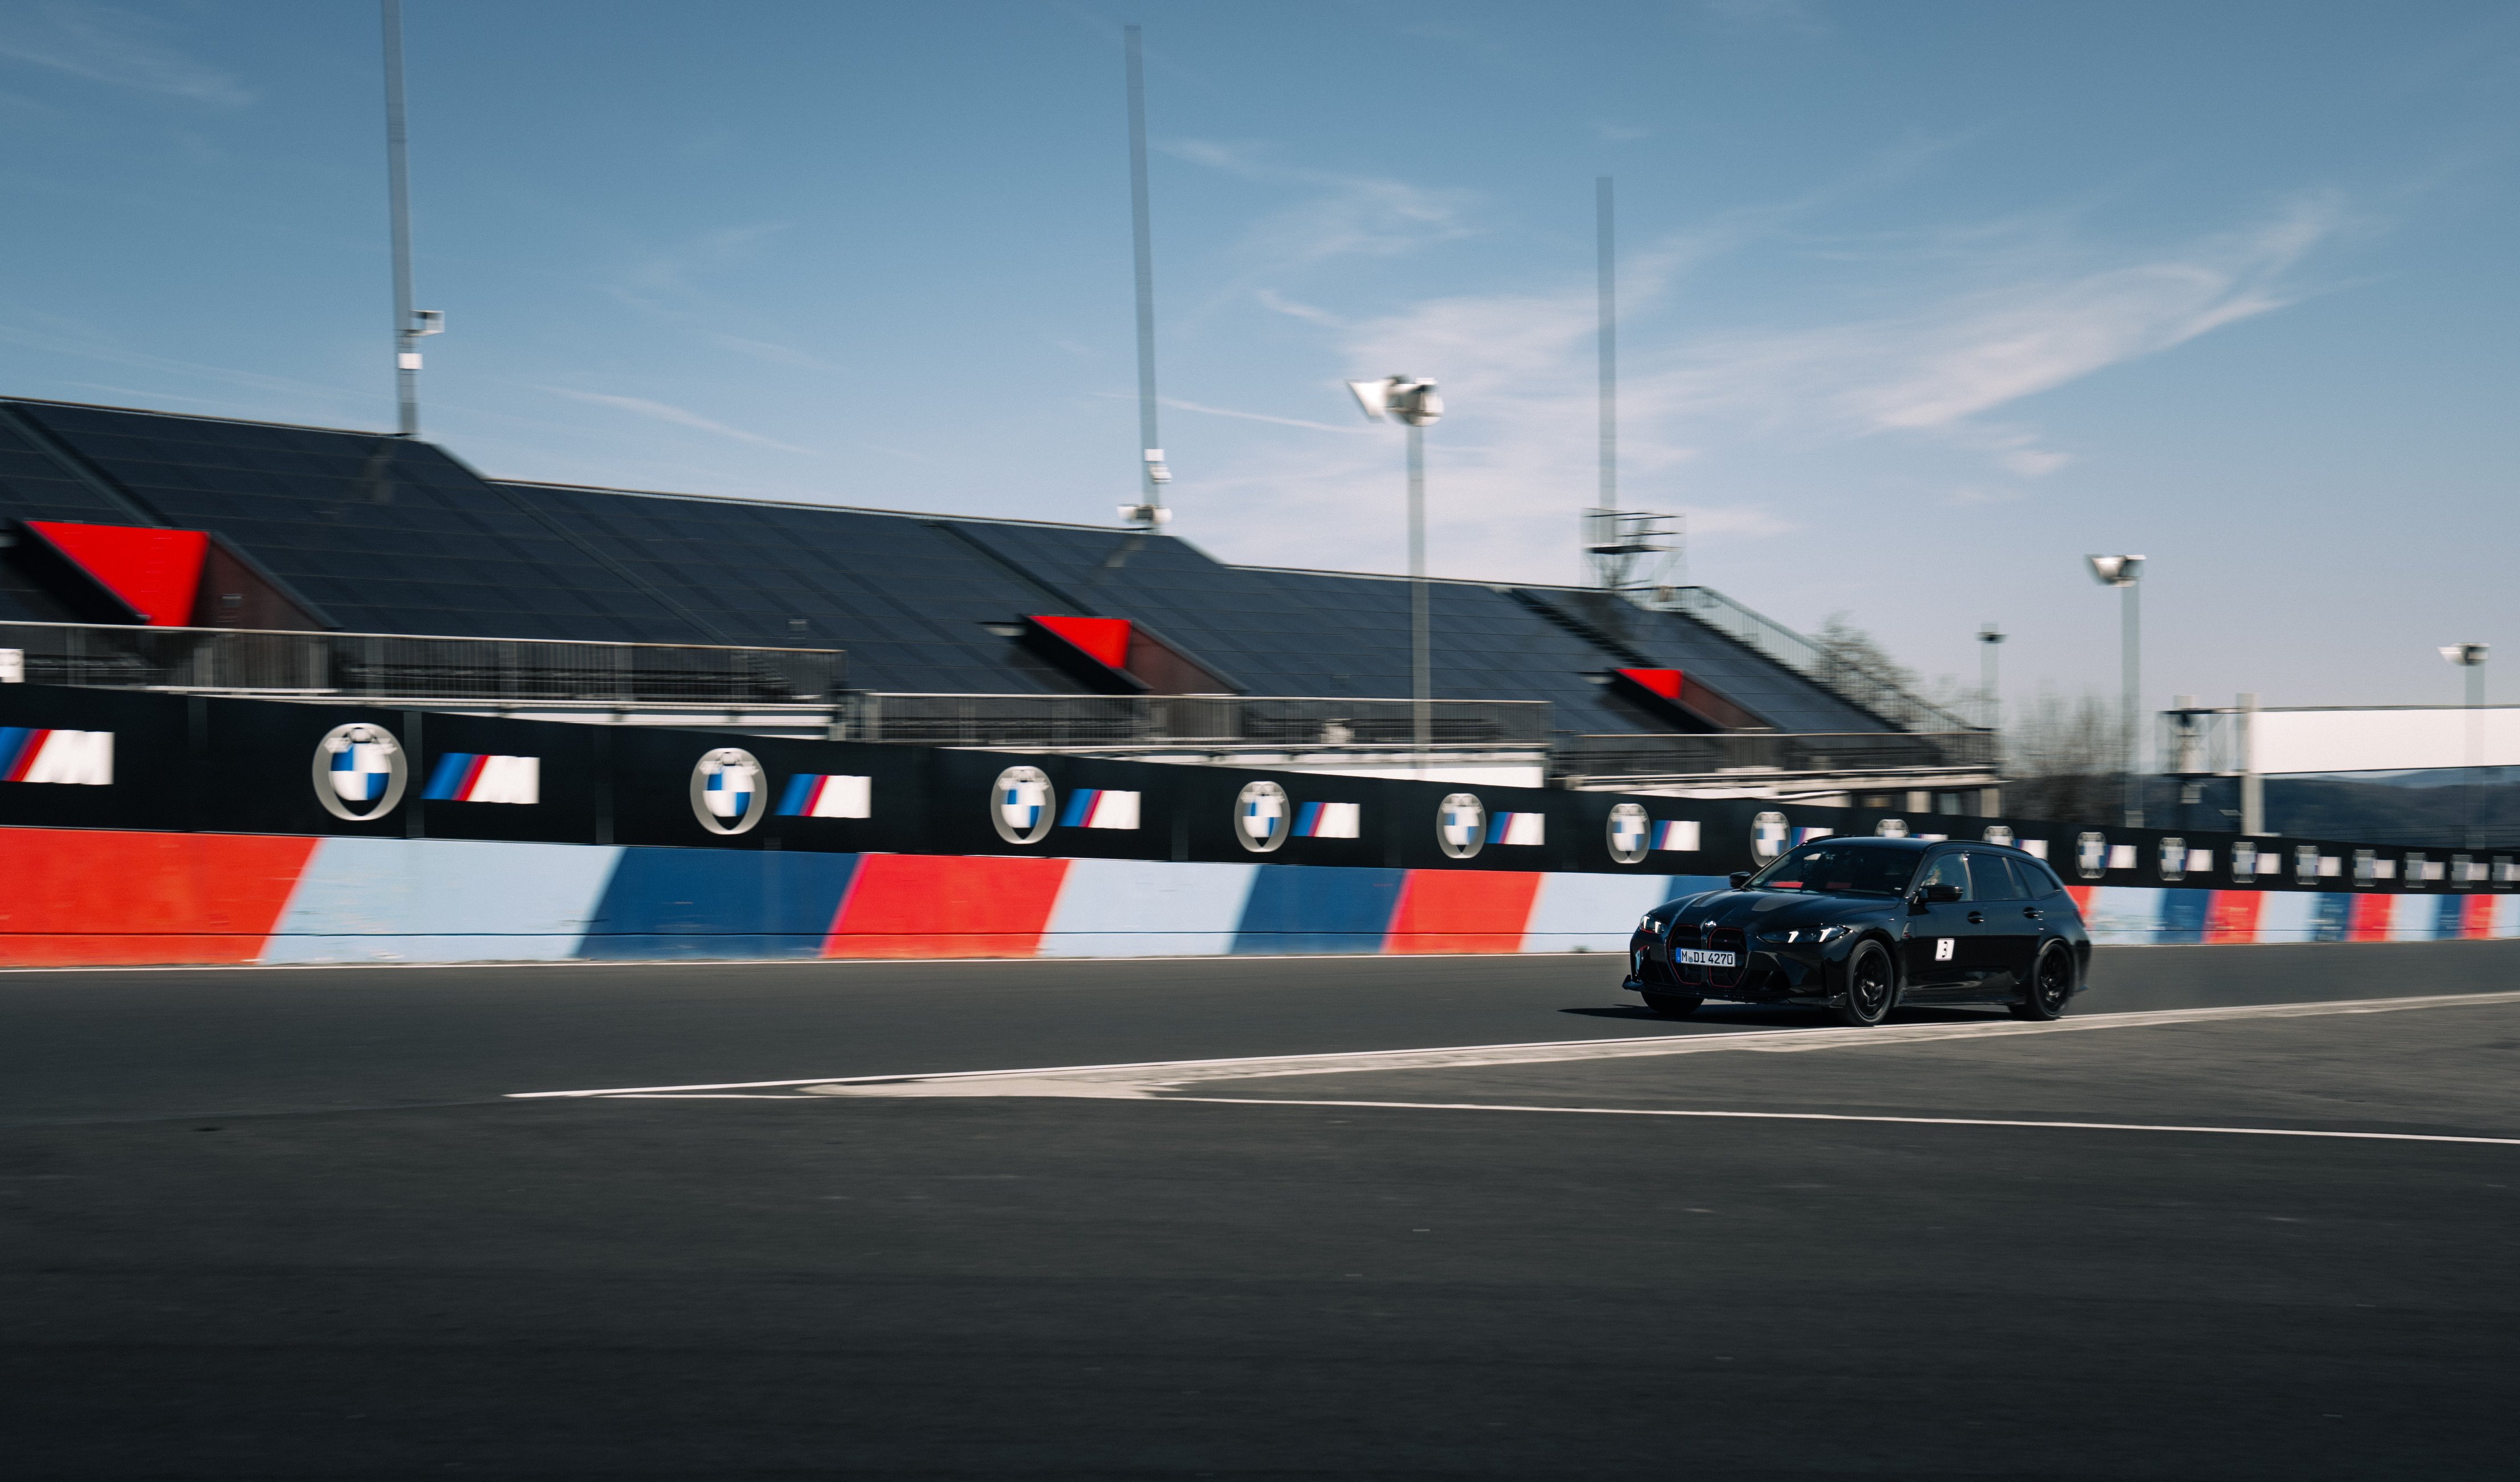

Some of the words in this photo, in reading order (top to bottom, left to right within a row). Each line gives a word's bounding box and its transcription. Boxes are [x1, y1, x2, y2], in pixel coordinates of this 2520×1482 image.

[1682, 951, 1687, 962] M
[1693, 952, 1705, 963] DI
[1708, 953, 1733, 964] 4270
